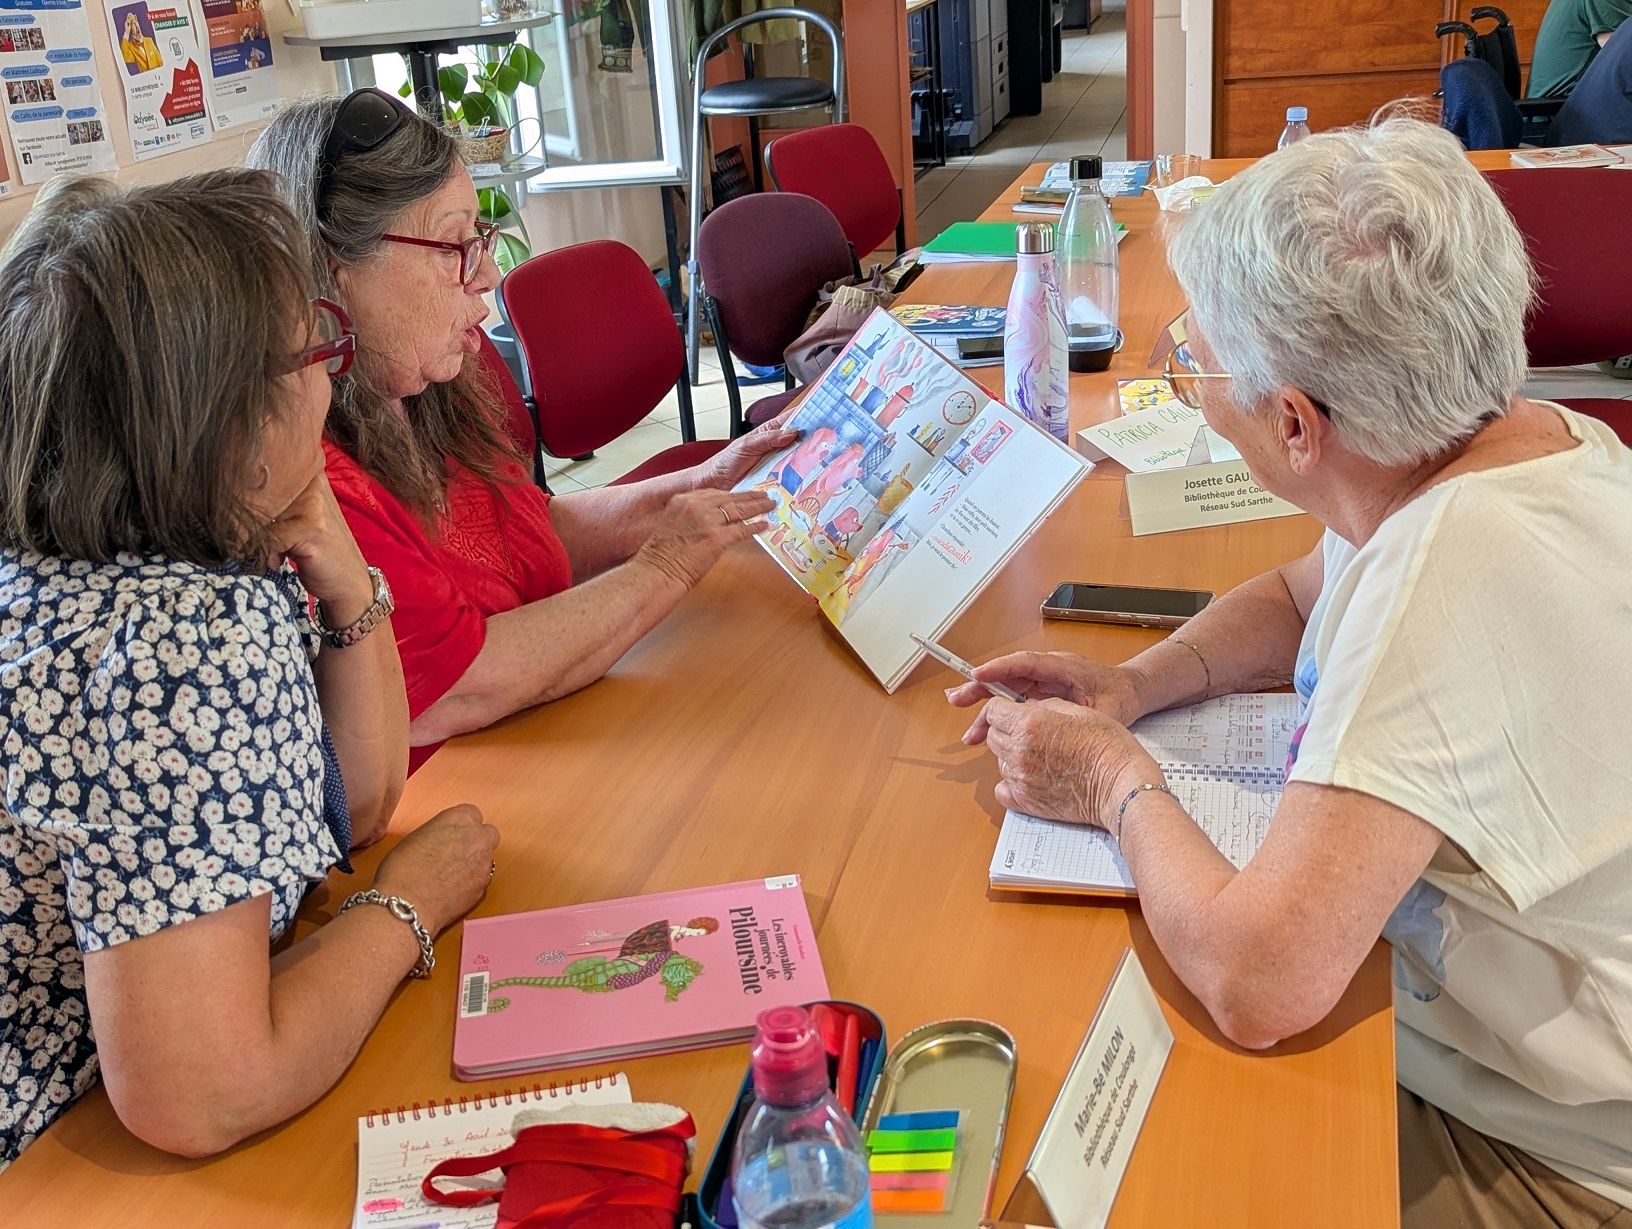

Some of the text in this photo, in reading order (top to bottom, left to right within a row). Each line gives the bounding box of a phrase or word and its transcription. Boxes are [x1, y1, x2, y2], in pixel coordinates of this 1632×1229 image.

[1098, 421, 1165, 448] PATRICIA
[1184, 472, 1253, 490] Josette GAU
[1184, 486, 1267, 503] Bibliothèque de Cou
[1200, 496, 1274, 513] Réseau Sud Sarthe
[729, 905, 766, 995] Piloursine
[753, 928, 780, 980] journées de
[772, 918, 796, 981] Les incroyables
[1074, 1025, 1124, 1138] Marie-Bé MILON
[1083, 1101, 1113, 1168] Bibliothèque
[1110, 1086, 1119, 1104] de
[1100, 1078, 1138, 1170] Réseau Sud Sarthe
